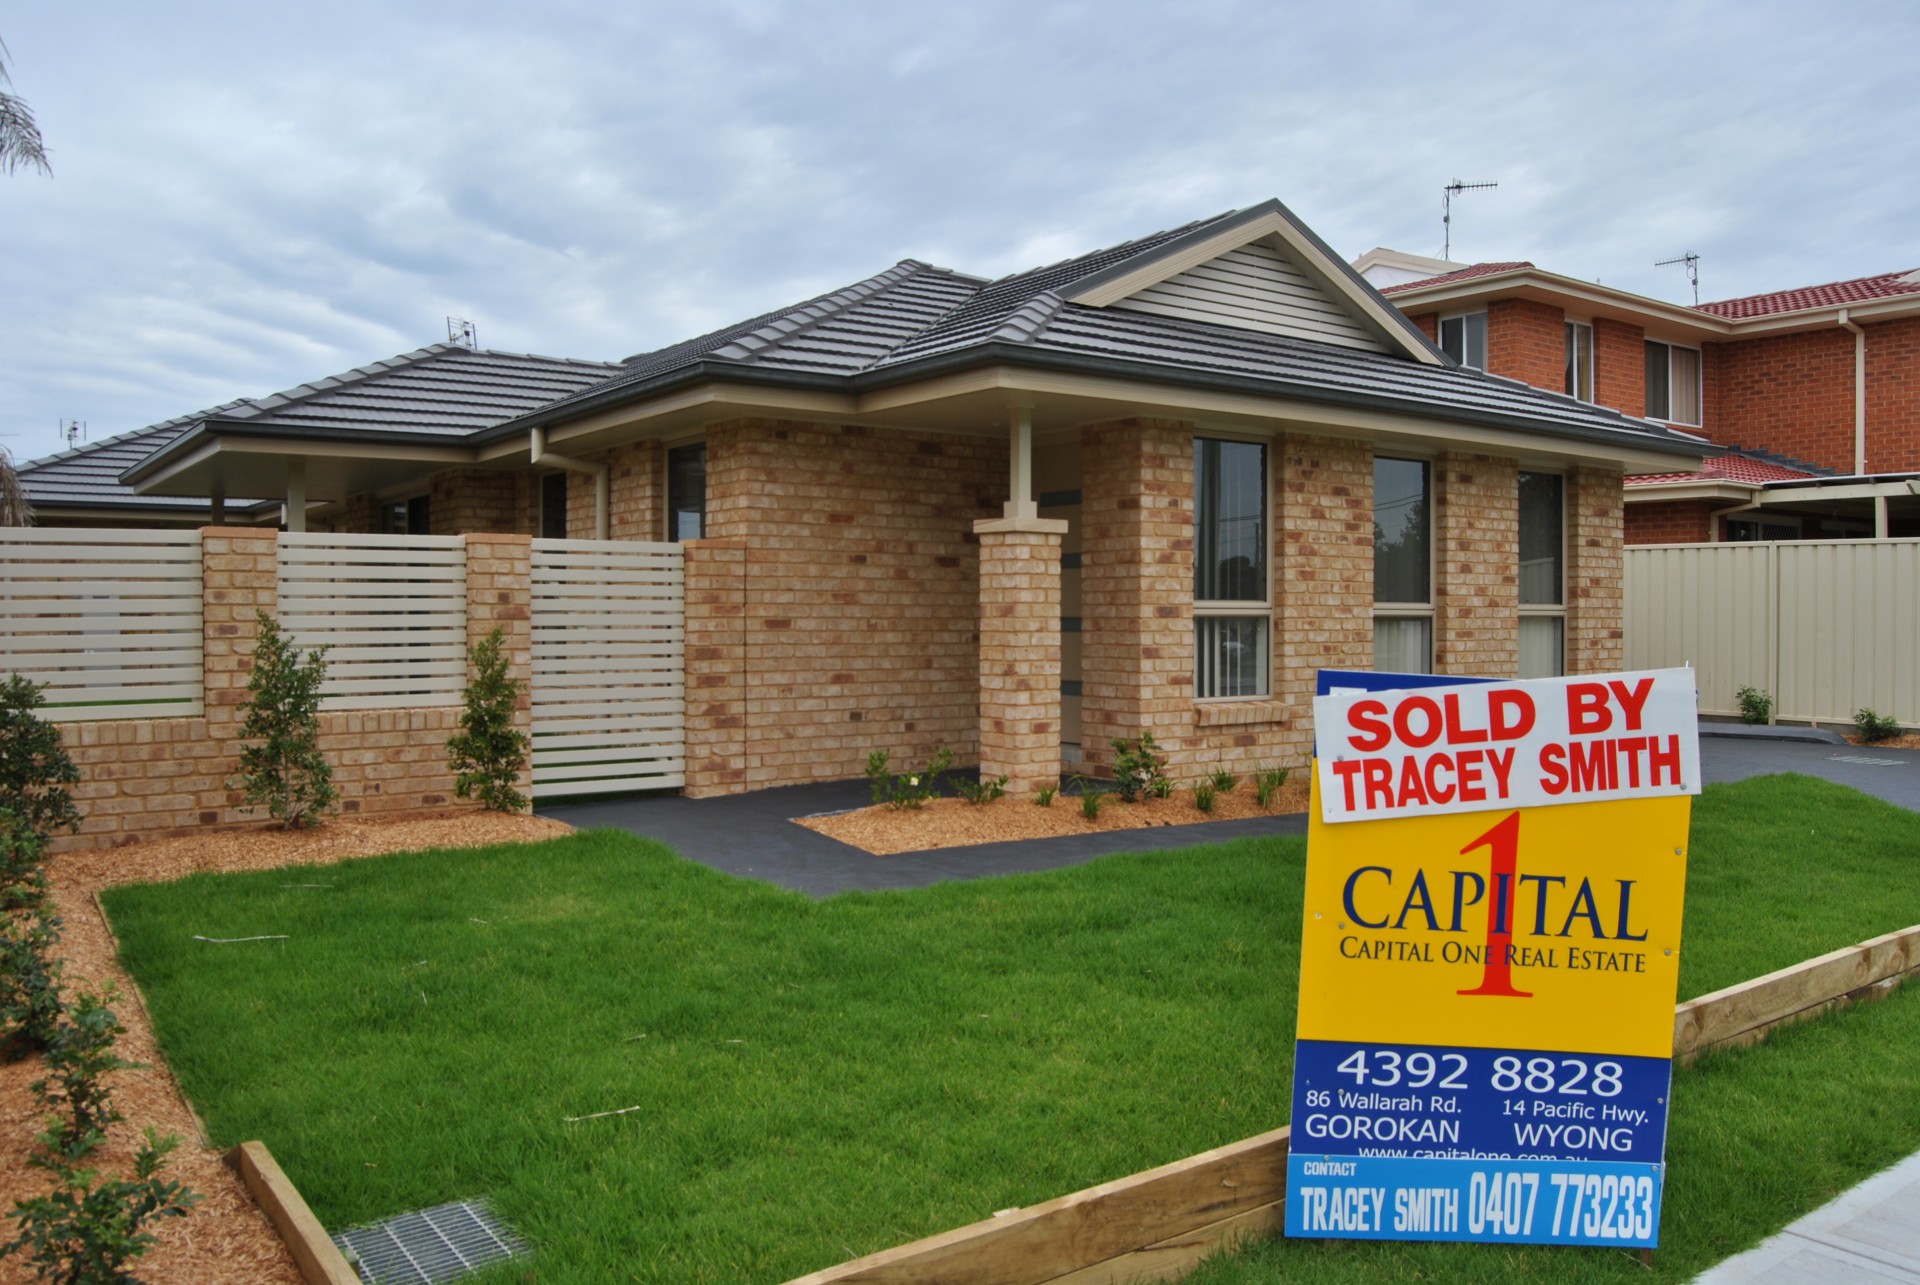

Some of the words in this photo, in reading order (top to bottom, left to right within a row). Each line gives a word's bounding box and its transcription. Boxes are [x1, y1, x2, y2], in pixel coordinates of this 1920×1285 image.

[1346, 689, 1536, 752] SOLD
[1566, 678, 1655, 734] BY
[1332, 747, 1516, 811] TRACEY
[1539, 734, 1681, 795] SMITH
[1342, 866, 1648, 941] CAPITAL
[1337, 1050, 1468, 1089] 4392
[1490, 1056, 1623, 1097] 8828
[1306, 1091, 1331, 1108] 86
[1339, 1092, 1424, 1111] Wallarah
[1430, 1096, 1462, 1113] Rd.
[1502, 1100, 1526, 1116] 14
[1532, 1101, 1595, 1120] Pacific
[1601, 1104, 1649, 1123] Hwy.
[1305, 1114, 1460, 1143] GOROKAN
[1514, 1122, 1633, 1151] WYONG
[1304, 1161, 1357, 1176] CONTACT
[1301, 1187, 1386, 1232] TRACEY
[1394, 1188, 1459, 1232] SMITH
[1469, 1171, 1540, 1235] 0407
[1550, 1173, 1654, 1240] 773233
